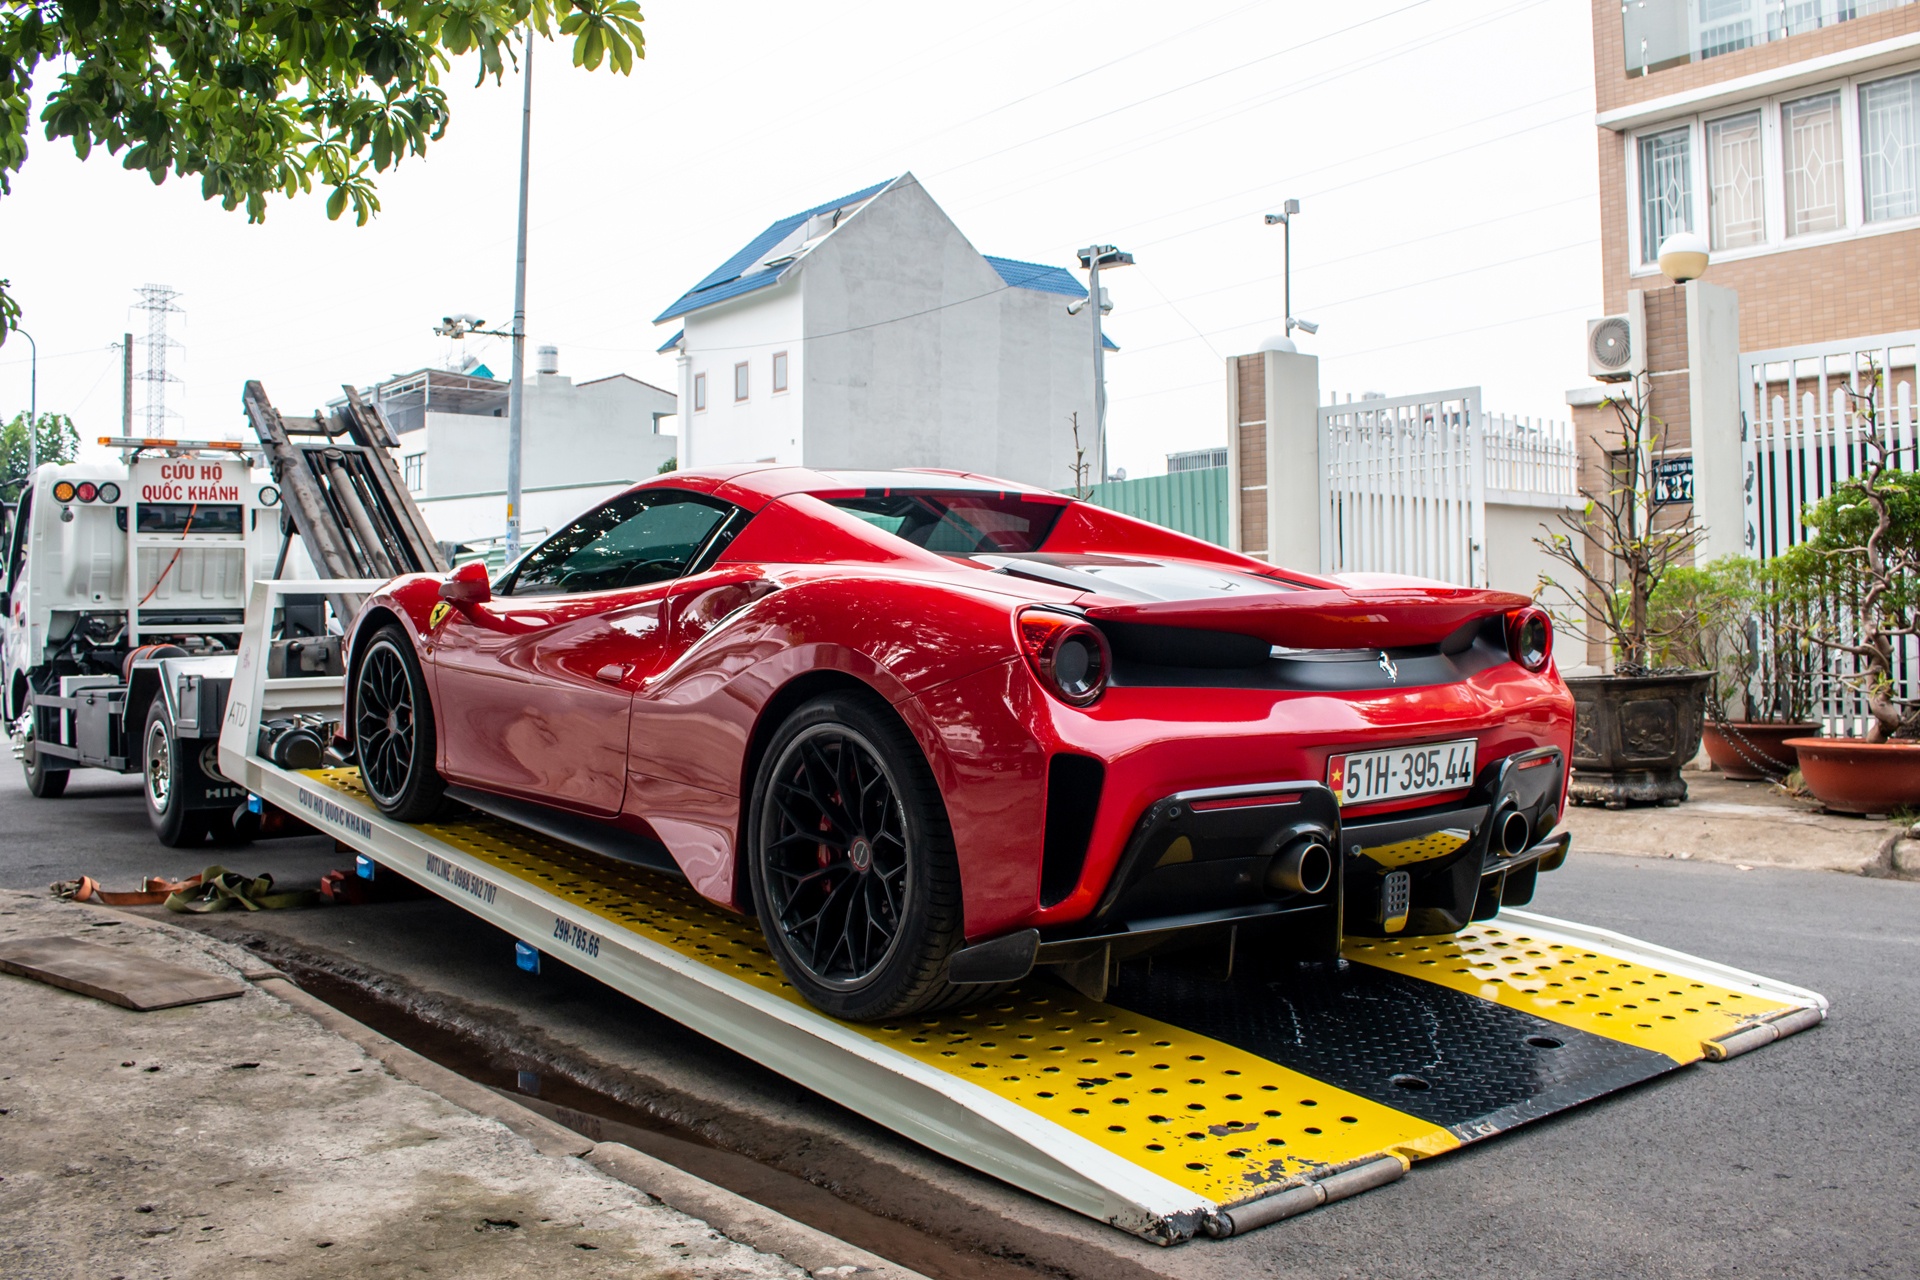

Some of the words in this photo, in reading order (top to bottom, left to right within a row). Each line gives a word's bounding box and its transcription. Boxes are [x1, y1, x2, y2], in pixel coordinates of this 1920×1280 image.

[161, 460, 195, 480] CỨU
[200, 462, 222, 483] HỘ
[142, 479, 183, 504] QUỐC
[188, 480, 238, 501] KHÁNH
[1346, 746, 1471, 799] 51H-395.44
[205, 787, 247, 799] HIN
[426, 852, 452, 882] HOTLINE
[454, 867, 471, 892] 0988
[470, 875, 484, 899] 502
[483, 882, 498, 905] 707
[553, 917, 600, 958] 29H-785.66
